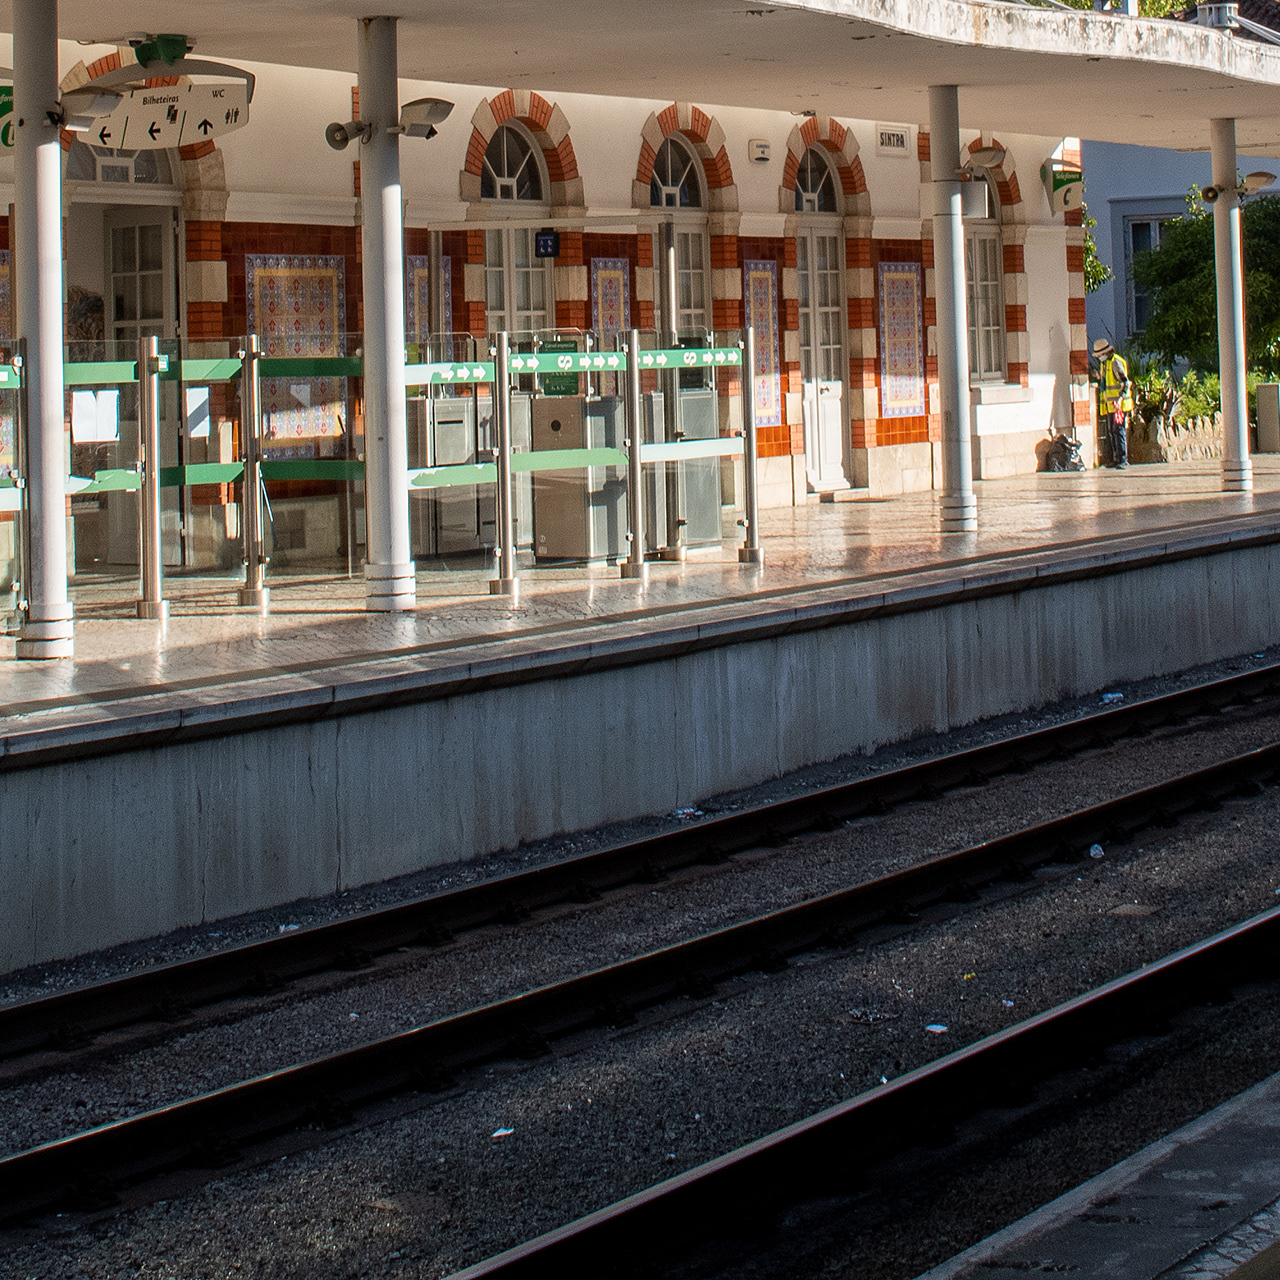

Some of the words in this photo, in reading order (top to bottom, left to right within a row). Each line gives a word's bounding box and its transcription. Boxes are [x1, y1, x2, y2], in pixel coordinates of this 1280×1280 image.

[142, 94, 179, 106] Bilheteiras
[211, 89, 225, 99] WC
[880, 132, 905, 148] SINTRA
